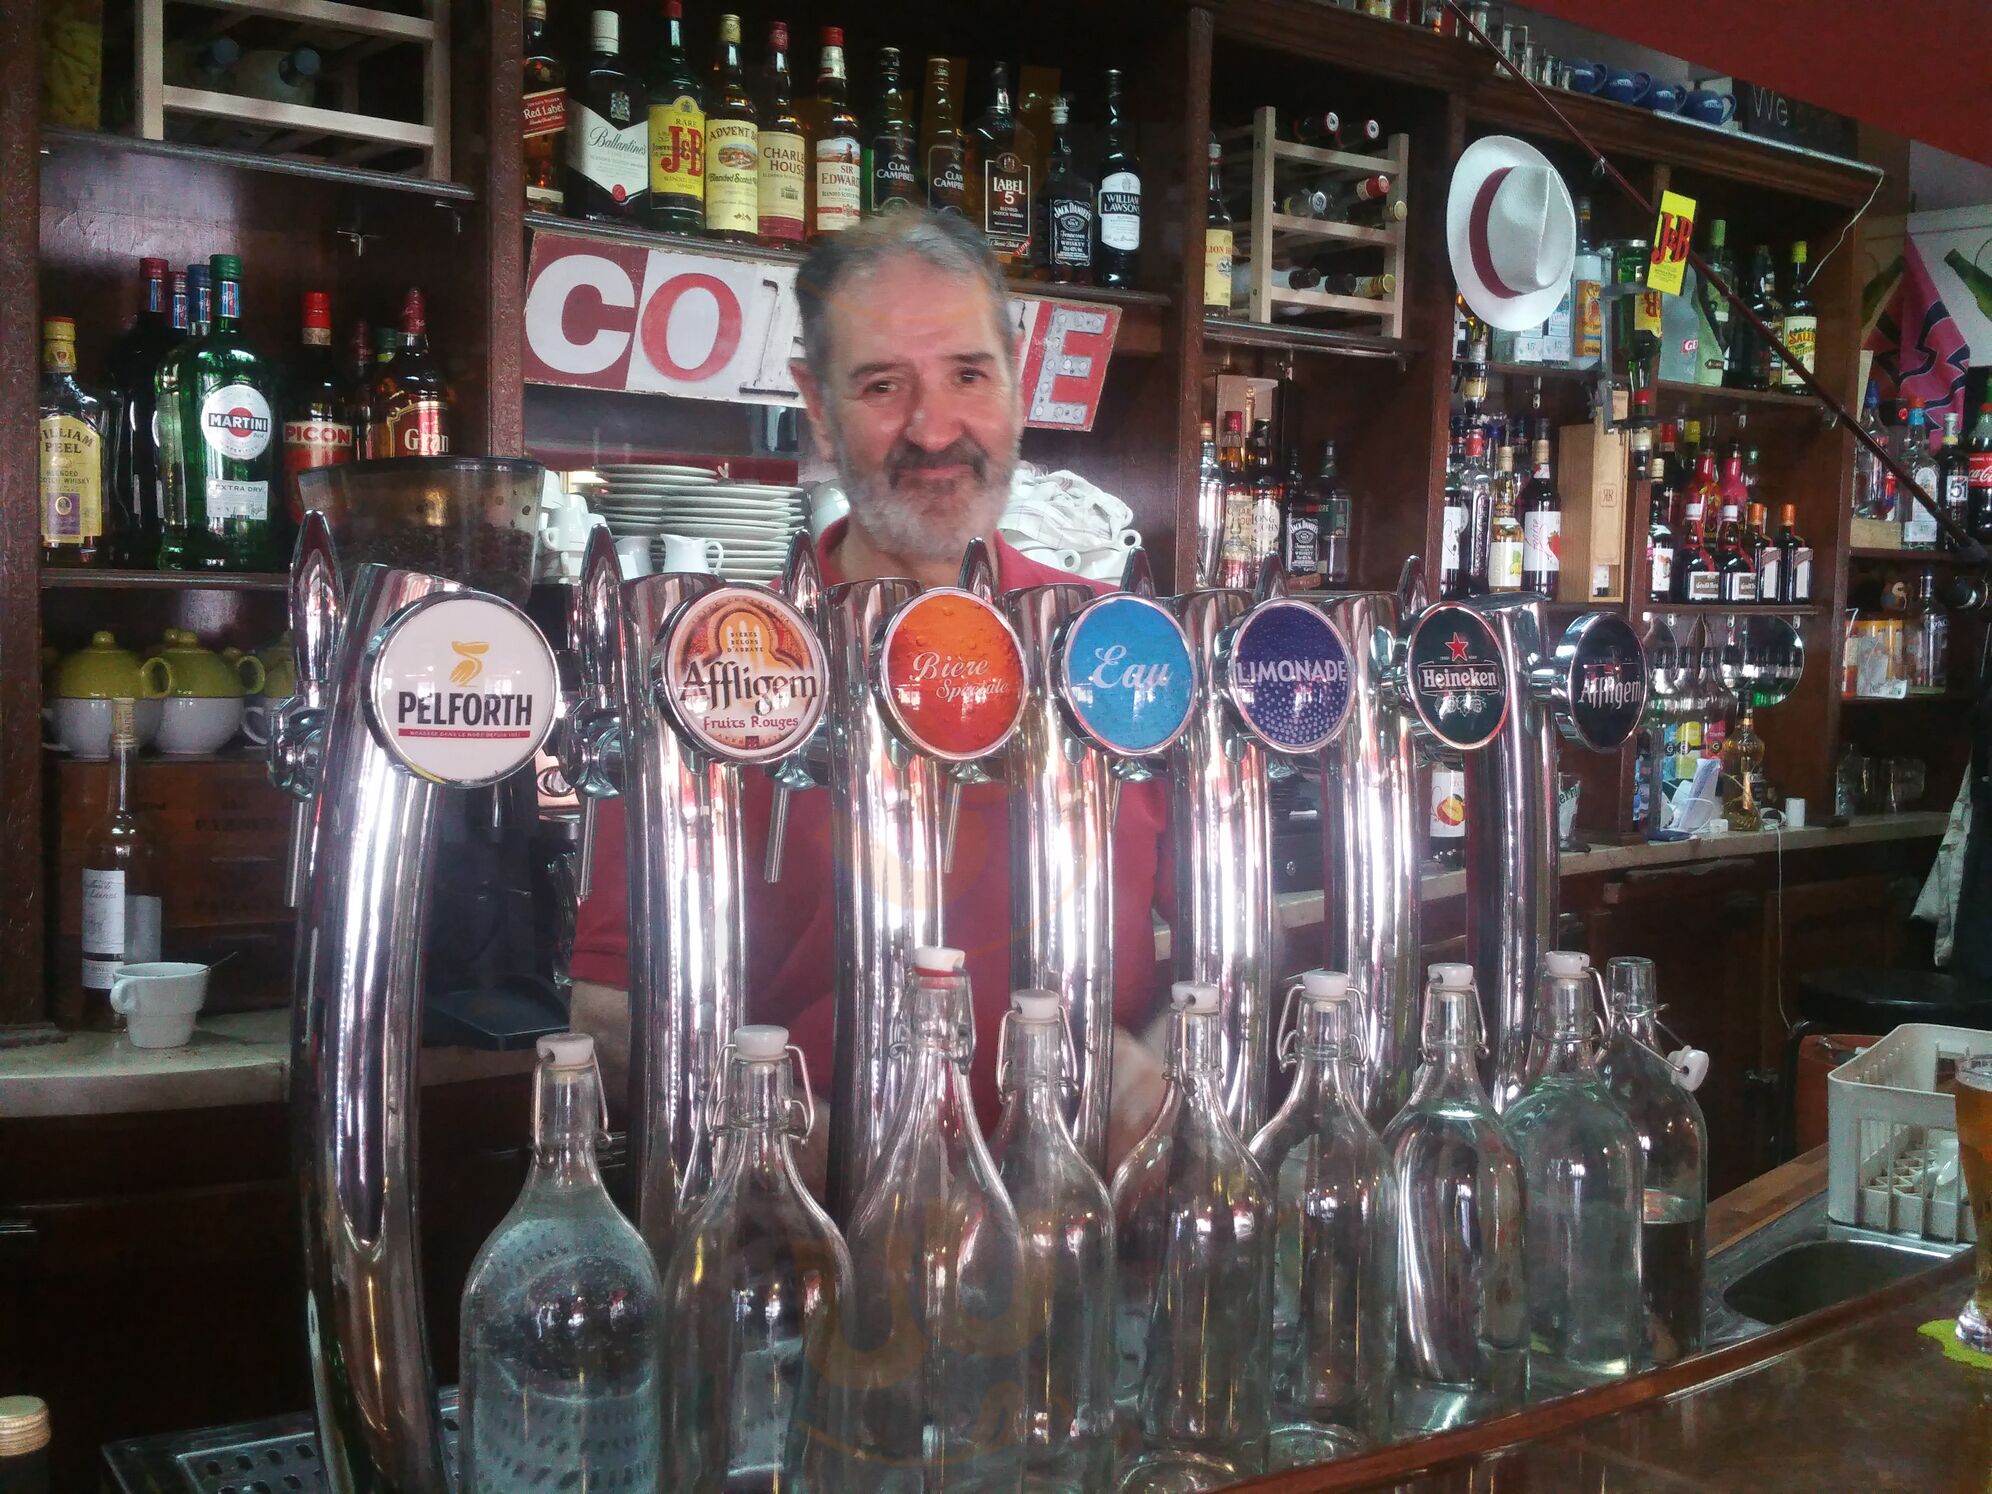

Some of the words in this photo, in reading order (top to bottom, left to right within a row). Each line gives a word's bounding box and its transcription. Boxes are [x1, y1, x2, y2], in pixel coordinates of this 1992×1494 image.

[523, 107, 542, 120] Red
[542, 102, 565, 115] Label
[587, 126, 647, 156] Ballantine's
[661, 126, 703, 177] J&B
[840, 165, 854, 175] SIR
[887, 161, 910, 173] CLAN
[993, 176, 1025, 195] LABEL
[1004, 192, 1014, 205] 5
[1054, 204, 1070, 218] JACK
[1651, 211, 1694, 265] J&B
[210, 414, 267, 431] MARTINI
[285, 424, 351, 445] PICON
[45, 442, 82, 454] PEEL
[1950, 480, 1967, 498] 51
[909, 651, 989, 681] Bière
[1091, 644, 1174, 689] Eau
[1236, 659, 1347, 683] LIMONADE
[679, 660, 818, 716] Affligem
[1422, 668, 1497, 689] Heineken
[936, 678, 1009, 702] Spéciale
[398, 691, 533, 726] PELFORTH
[703, 717, 746, 731] Fruits
[750, 716, 799, 730] Rouges
